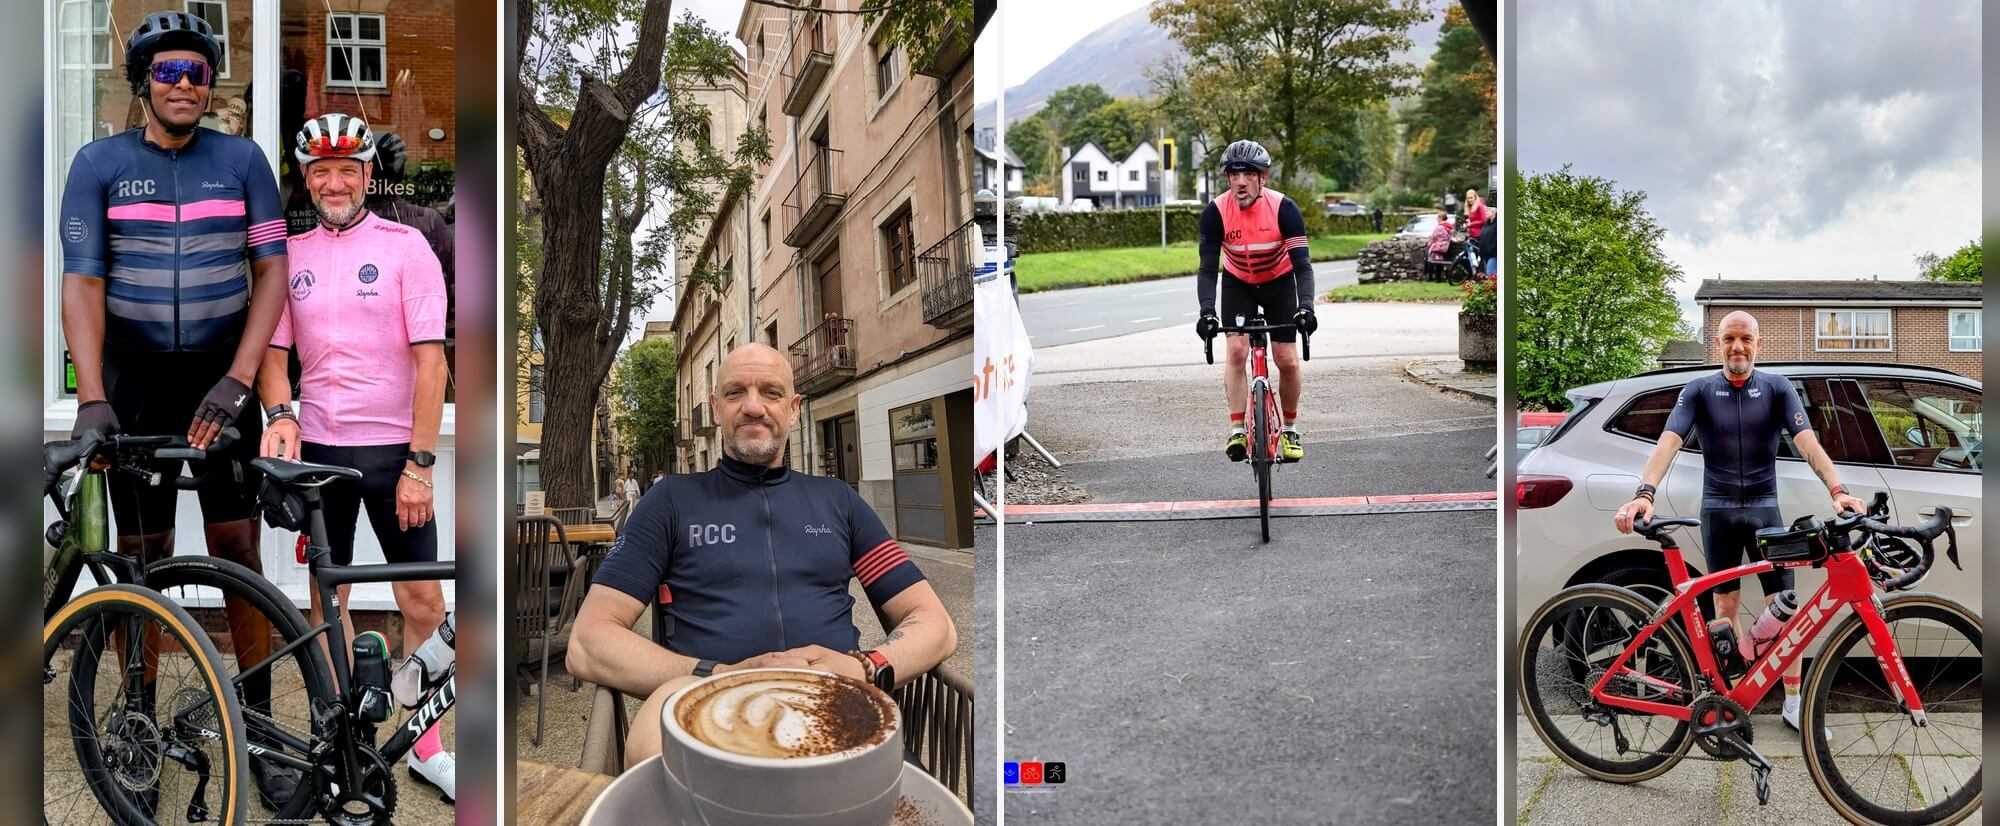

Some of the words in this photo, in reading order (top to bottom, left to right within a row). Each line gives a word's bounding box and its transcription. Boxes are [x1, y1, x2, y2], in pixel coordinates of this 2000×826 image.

[119, 180, 156, 198] RCC
[201, 181, 225, 191] Rapha
[365, 179, 416, 196] Bikes
[356, 288, 378, 299] Rapha
[689, 523, 737, 548] RCC
[804, 524, 833, 537] Rapha
[1745, 586, 1839, 689] TREK
[1890, 648, 1912, 688] TREK
